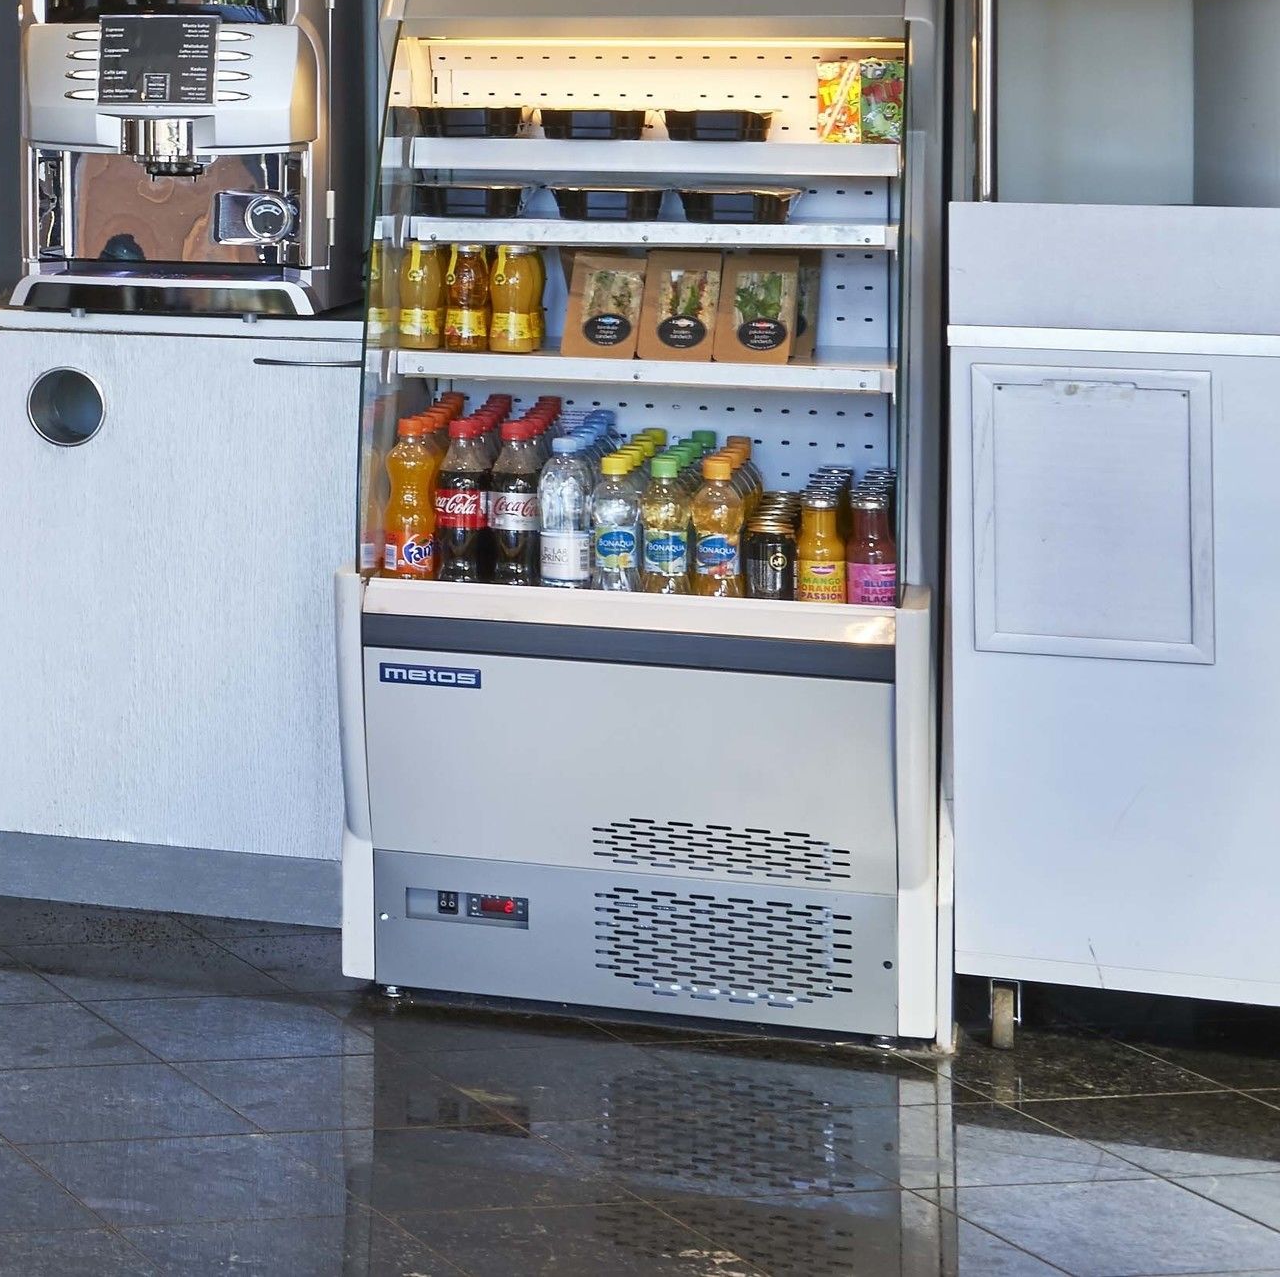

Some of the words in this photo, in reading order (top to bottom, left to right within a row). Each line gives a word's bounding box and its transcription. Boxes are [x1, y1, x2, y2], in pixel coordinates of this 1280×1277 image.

[648, 542, 685, 553] BONAQUA
[699, 544, 737, 555] BONAQUA
[802, 577, 840, 585] MANGO
[801, 584, 843, 592] ORANGE
[801, 592, 844, 600] PASSION
[384, 667, 476, 685] metos
